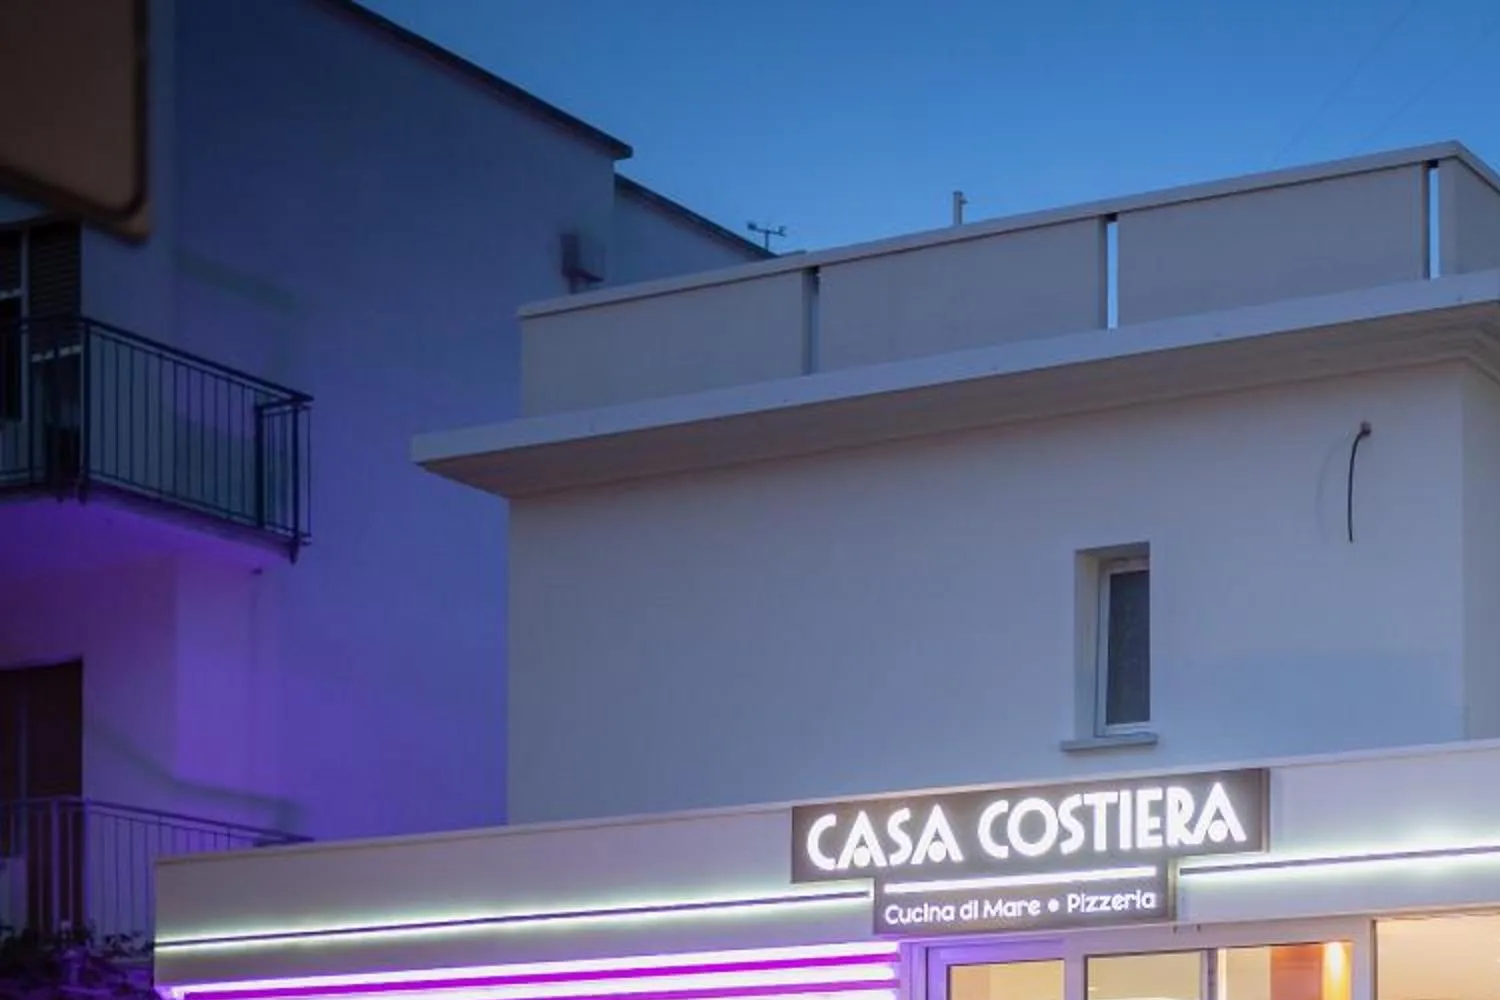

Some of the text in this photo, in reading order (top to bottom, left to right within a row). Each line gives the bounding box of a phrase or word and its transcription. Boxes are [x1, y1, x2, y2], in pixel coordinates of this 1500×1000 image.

[807, 782, 1247, 870] CASA COSTIERA
[884, 889, 1157, 925] Cucina di Mare Pizzeria
